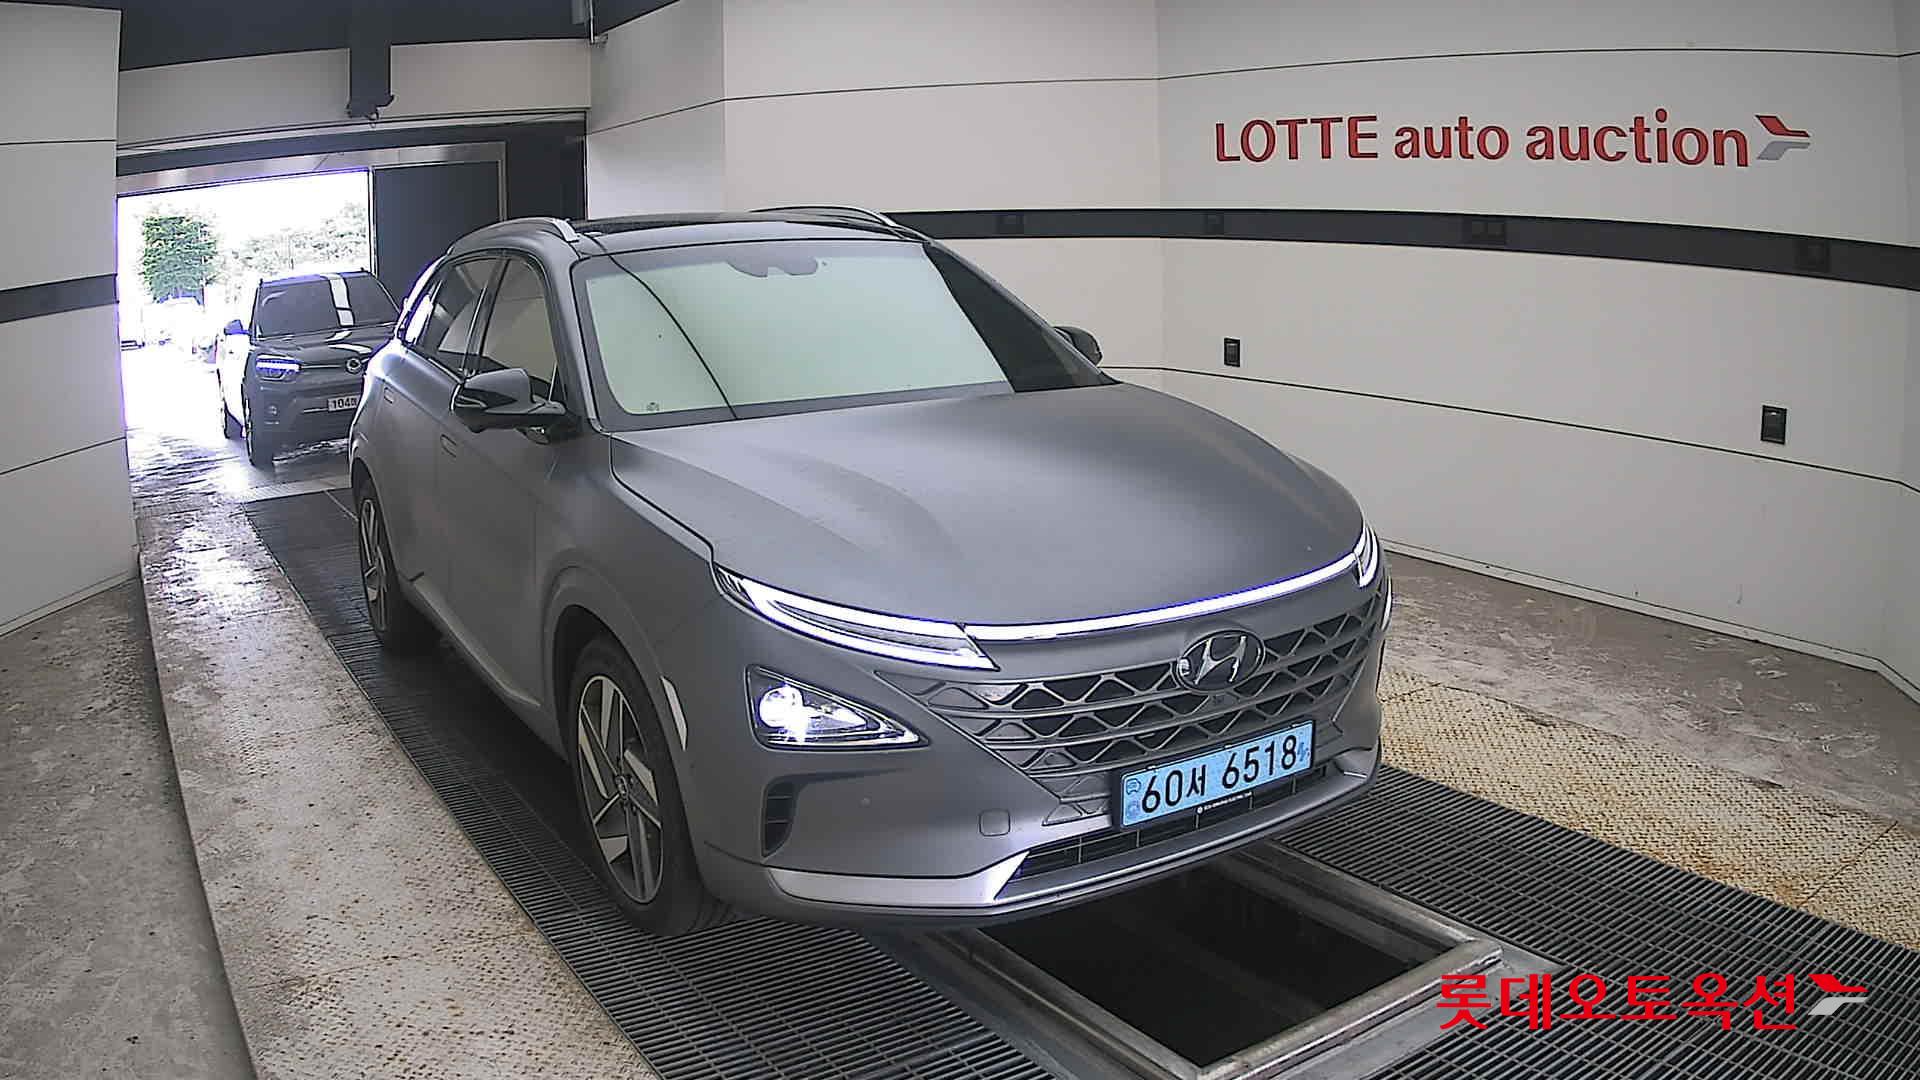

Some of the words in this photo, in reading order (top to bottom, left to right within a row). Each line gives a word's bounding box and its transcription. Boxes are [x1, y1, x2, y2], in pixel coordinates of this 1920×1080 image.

[1215, 115, 1378, 162] LOTTE
[1393, 115, 1510, 160] auto
[1525, 108, 1750, 168] auction
[1141, 763, 1207, 814] 60서
[1221, 734, 1298, 789] 6518
